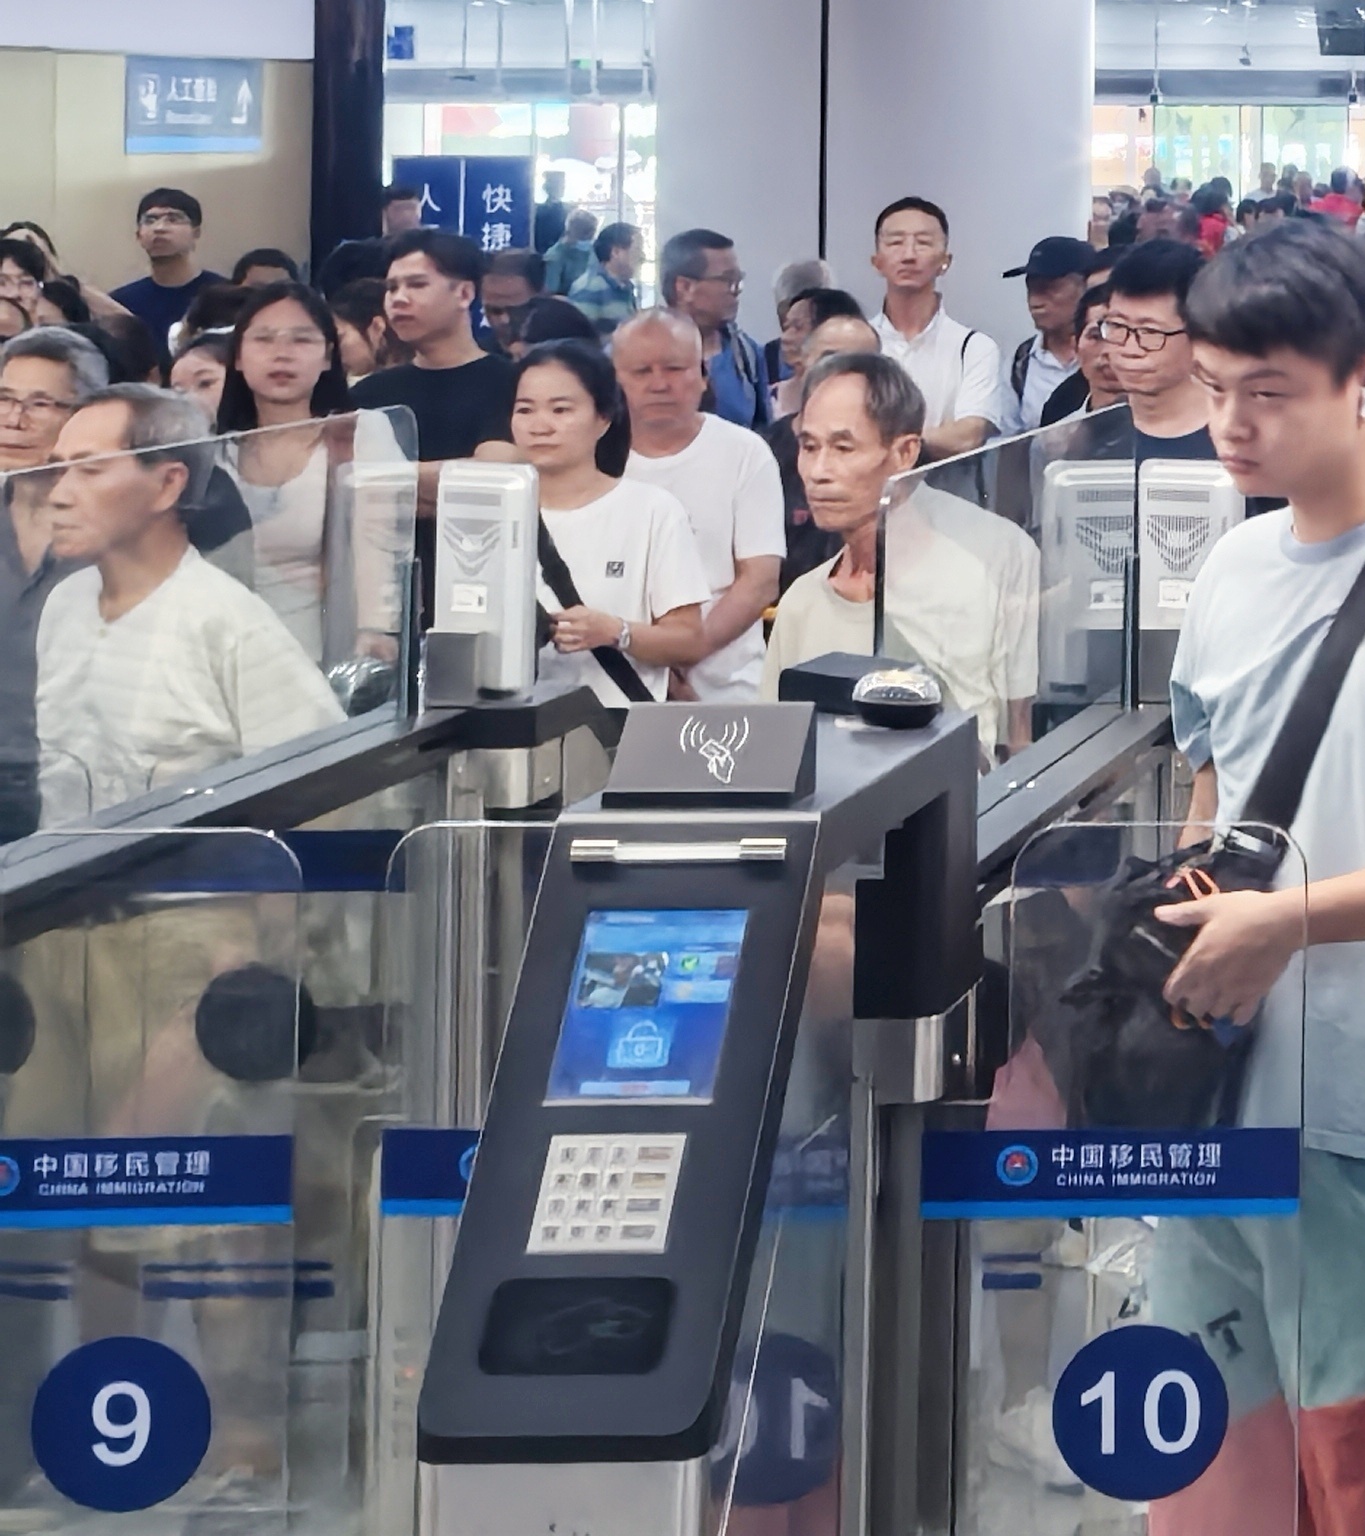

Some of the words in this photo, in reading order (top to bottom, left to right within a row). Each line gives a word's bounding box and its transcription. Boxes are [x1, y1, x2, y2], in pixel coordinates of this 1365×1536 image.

[33, 1150, 211, 1179] 中国移民管理
[1051, 1143, 1222, 1170] 中国移民管理
[1056, 1172, 1105, 1187] CHINA
[1112, 1171, 1217, 1187] IMMIGRATION
[91, 1381, 152, 1468] 9
[1080, 1370, 1202, 1457] 10
